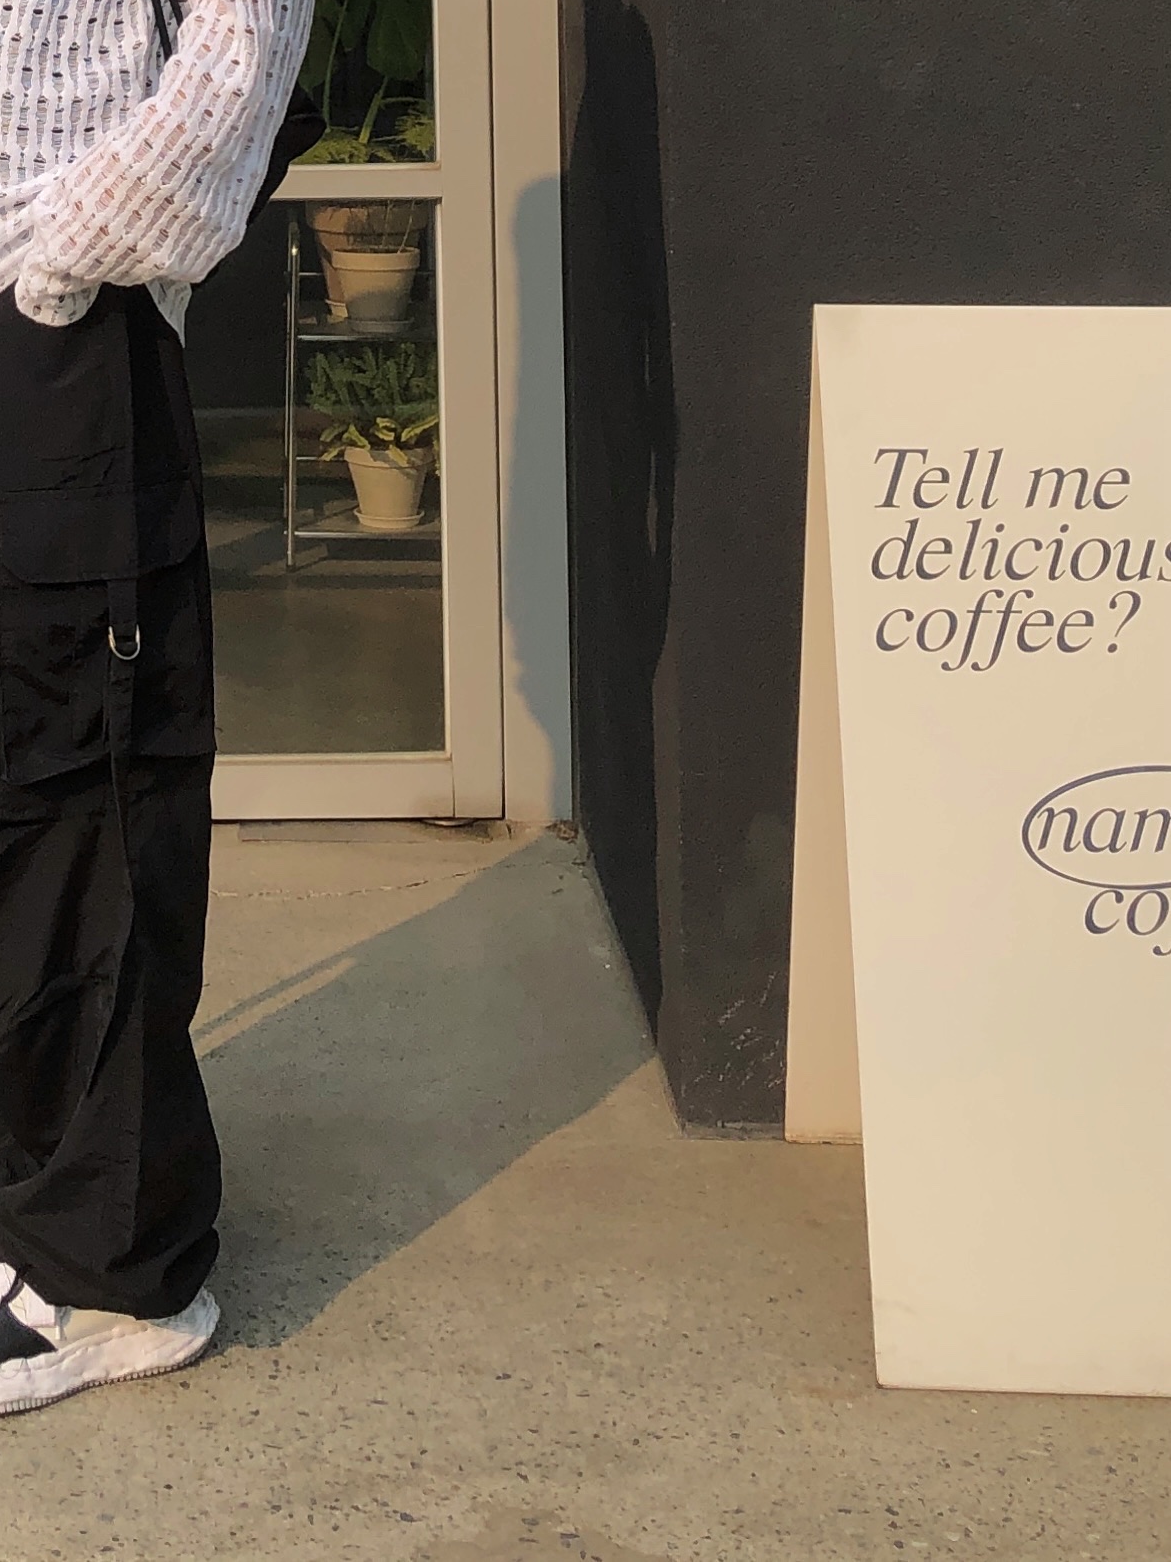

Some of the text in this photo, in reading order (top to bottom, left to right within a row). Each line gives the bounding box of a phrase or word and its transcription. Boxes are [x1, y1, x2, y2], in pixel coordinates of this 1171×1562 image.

[874, 447, 1130, 510] Tell me
[875, 589, 1141, 672] coffee?
[1084, 889, 1171, 957] co
